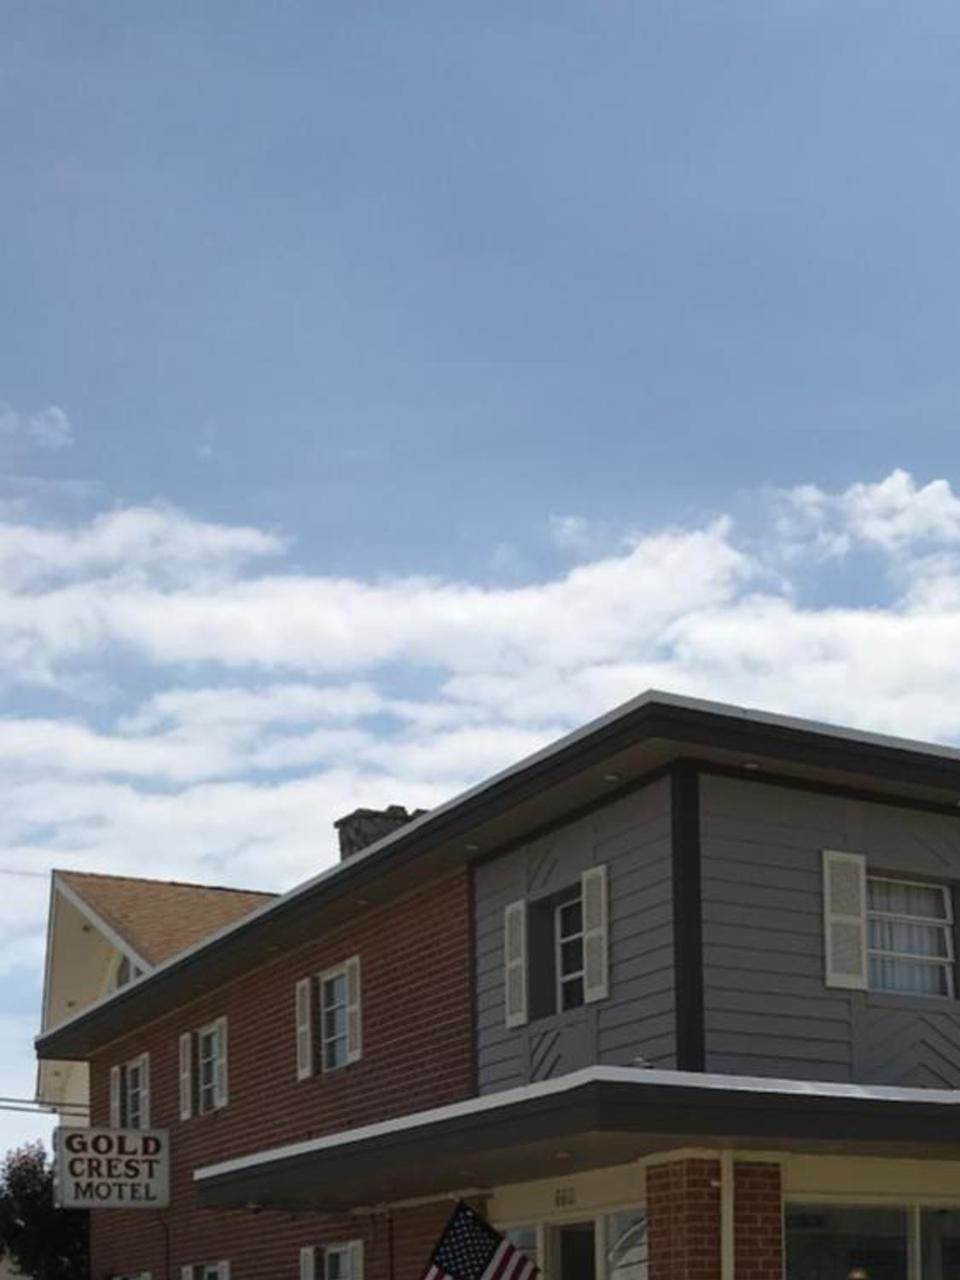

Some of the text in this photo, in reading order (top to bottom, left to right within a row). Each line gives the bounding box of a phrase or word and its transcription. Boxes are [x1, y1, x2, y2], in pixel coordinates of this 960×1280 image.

[65, 1133, 161, 1155] GOLD
[68, 1158, 160, 1179] CREST
[74, 1182, 157, 1201] MOTEL
